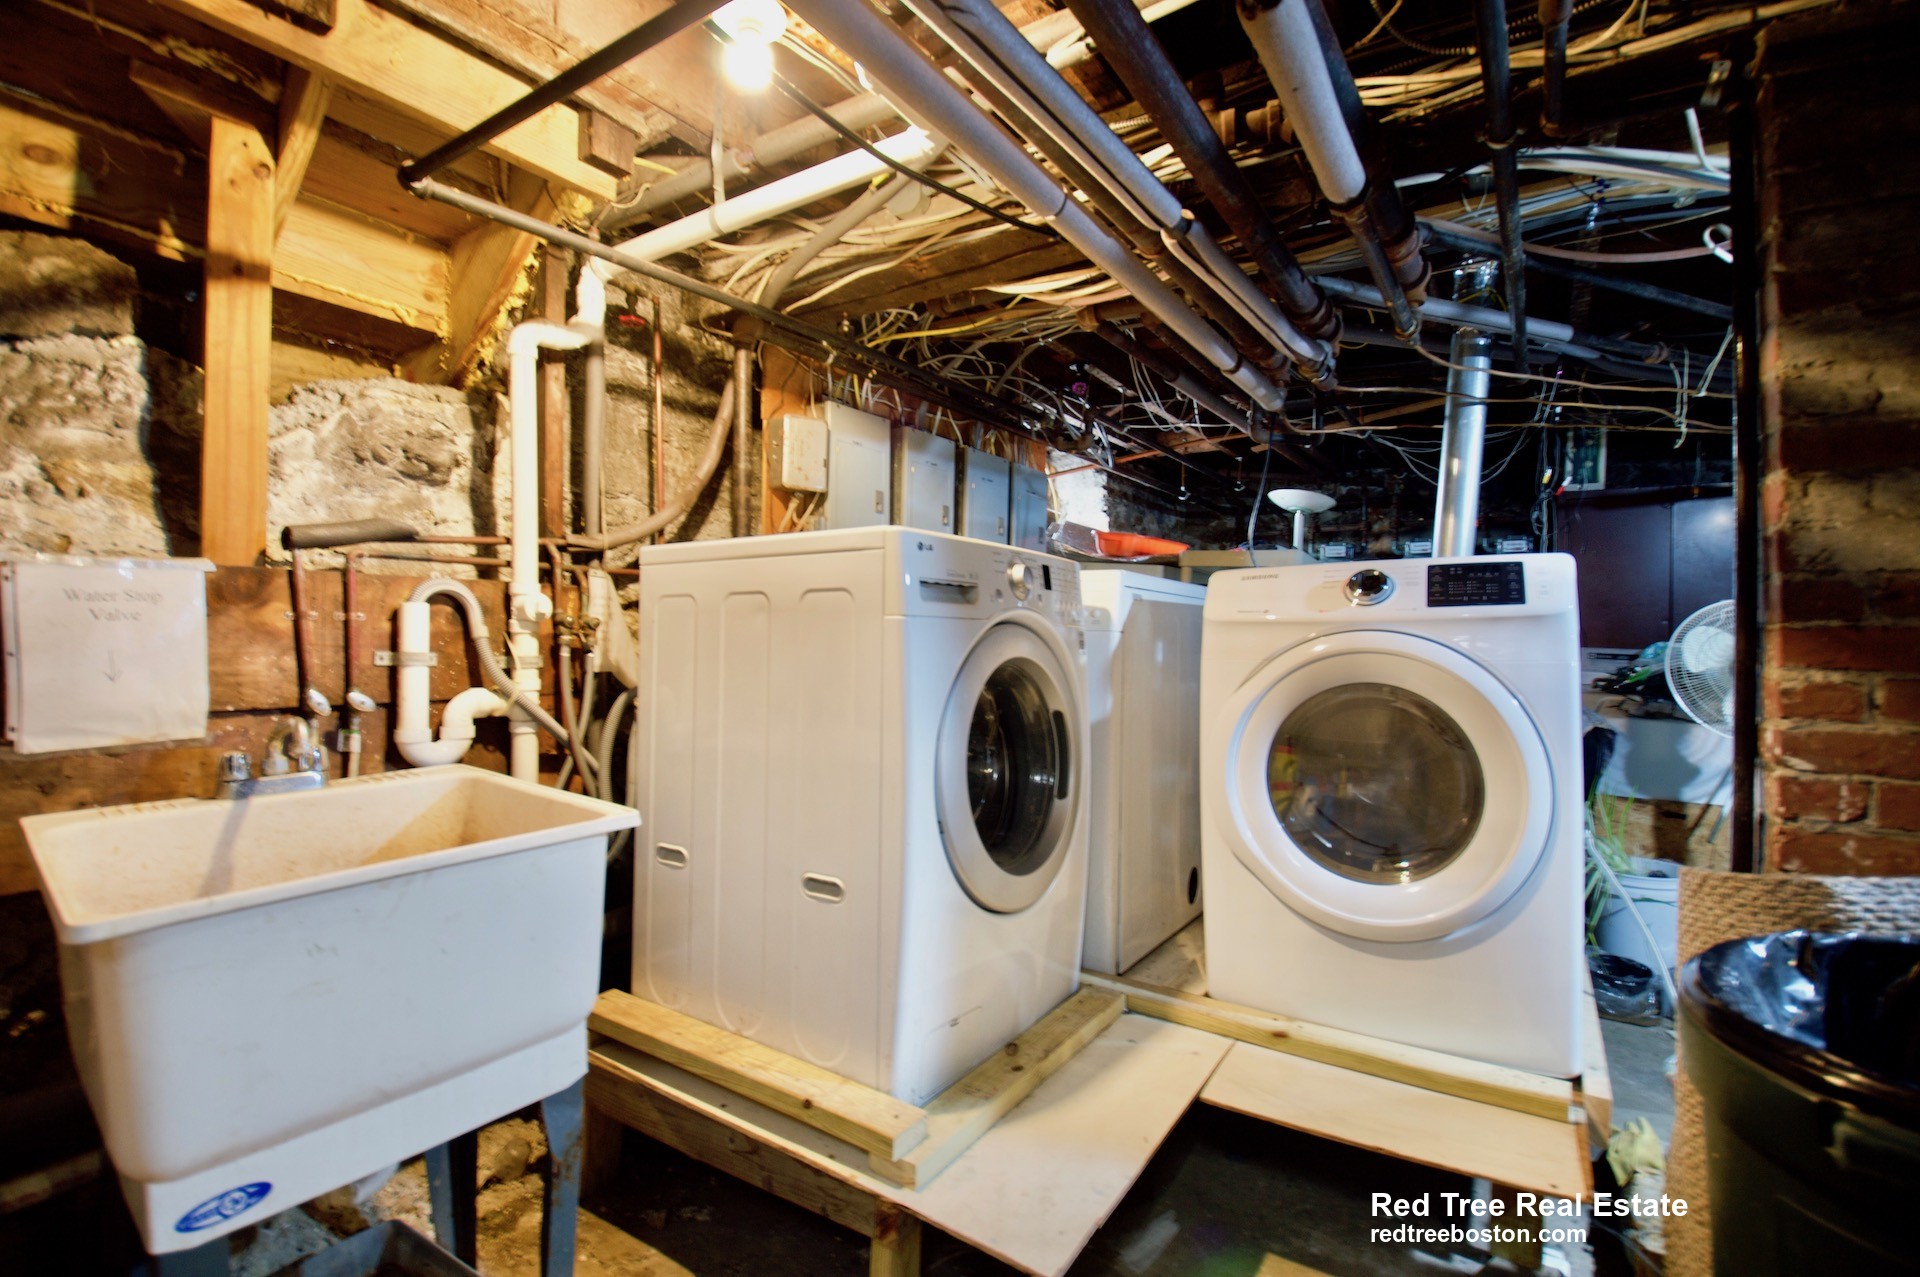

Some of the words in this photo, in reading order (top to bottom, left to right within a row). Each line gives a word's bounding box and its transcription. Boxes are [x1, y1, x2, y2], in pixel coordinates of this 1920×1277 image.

[1241, 573, 1279, 581] SAMSUNG
[62, 588, 118, 602] Water
[123, 589, 163, 605] Stop
[89, 608, 141, 622] Valve
